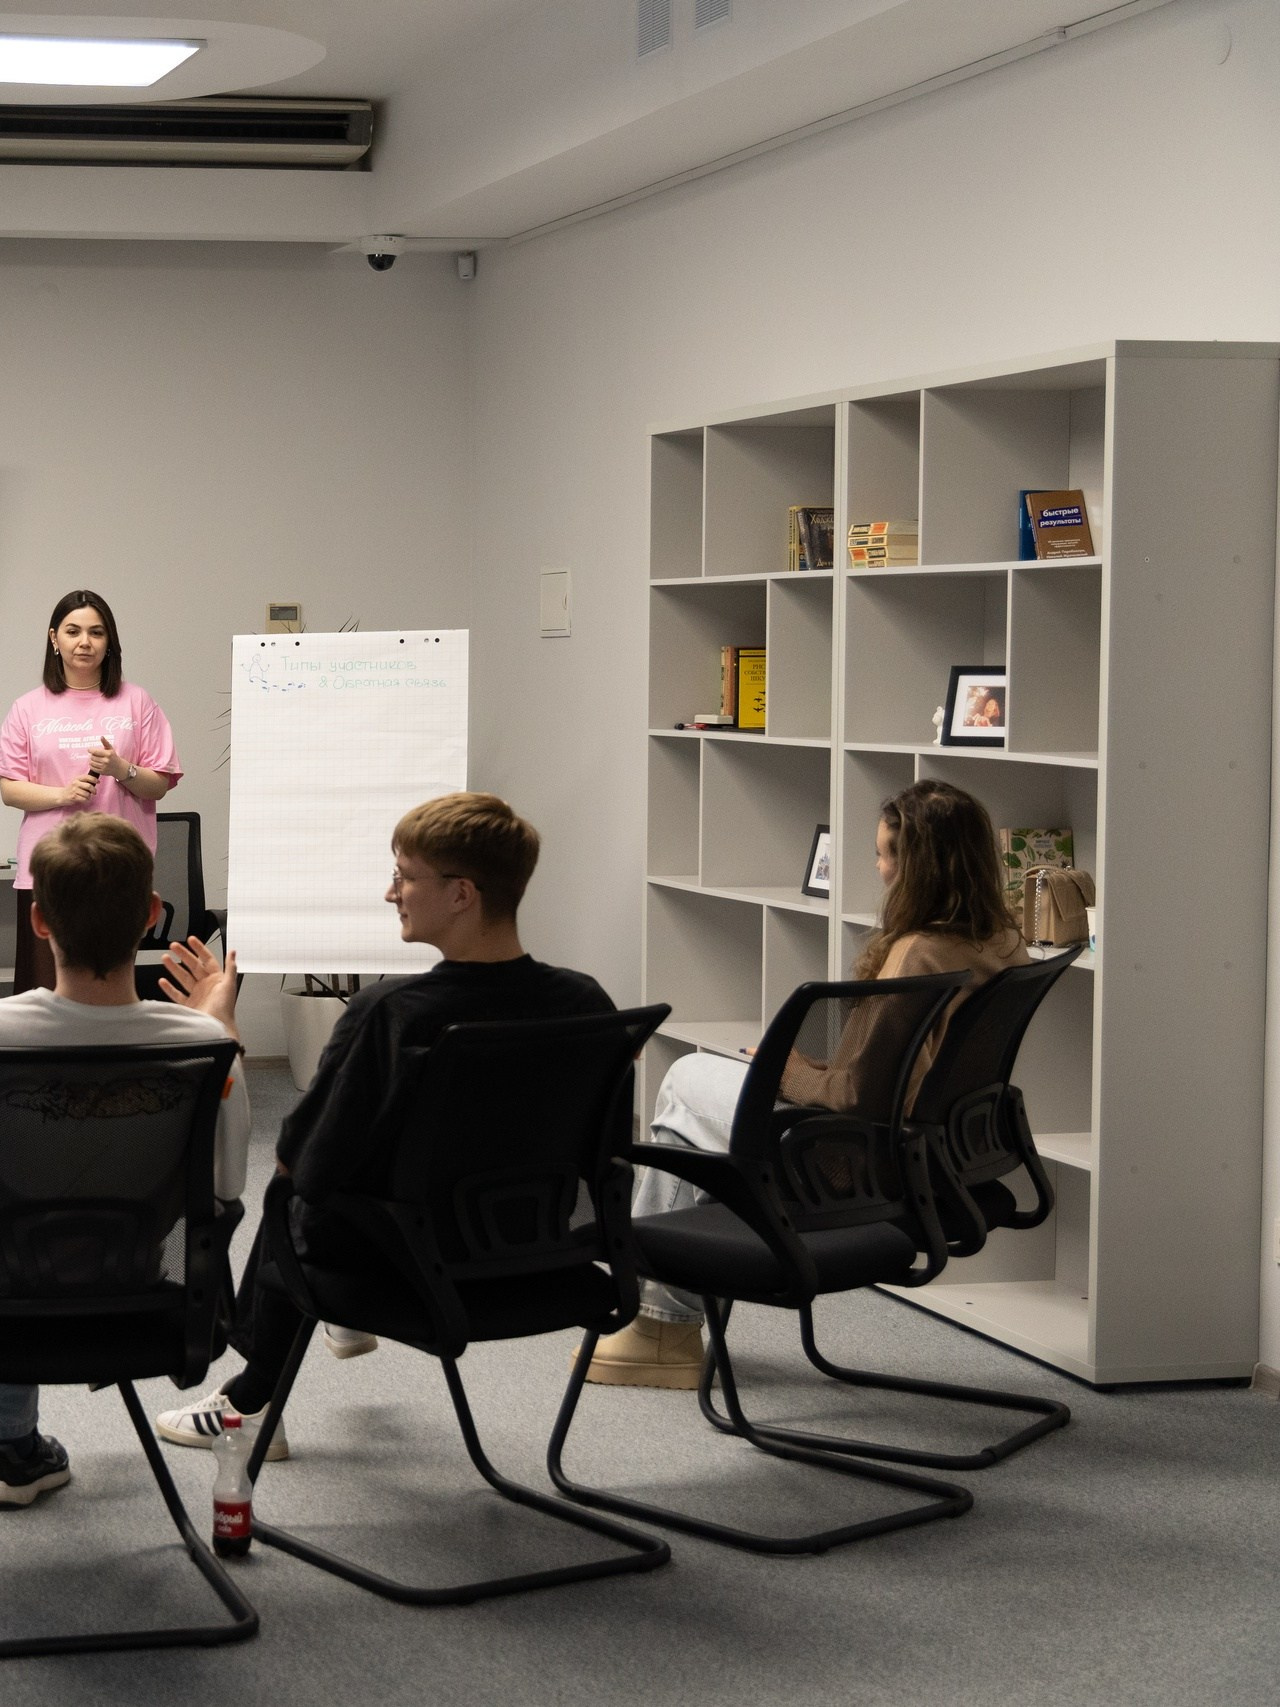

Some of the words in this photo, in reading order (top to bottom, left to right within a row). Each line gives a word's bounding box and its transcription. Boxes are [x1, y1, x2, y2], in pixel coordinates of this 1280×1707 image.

[1043, 507, 1079, 517] быстрые
[1040, 518, 1081, 528] результаты
[280, 655, 321, 672] Типы
